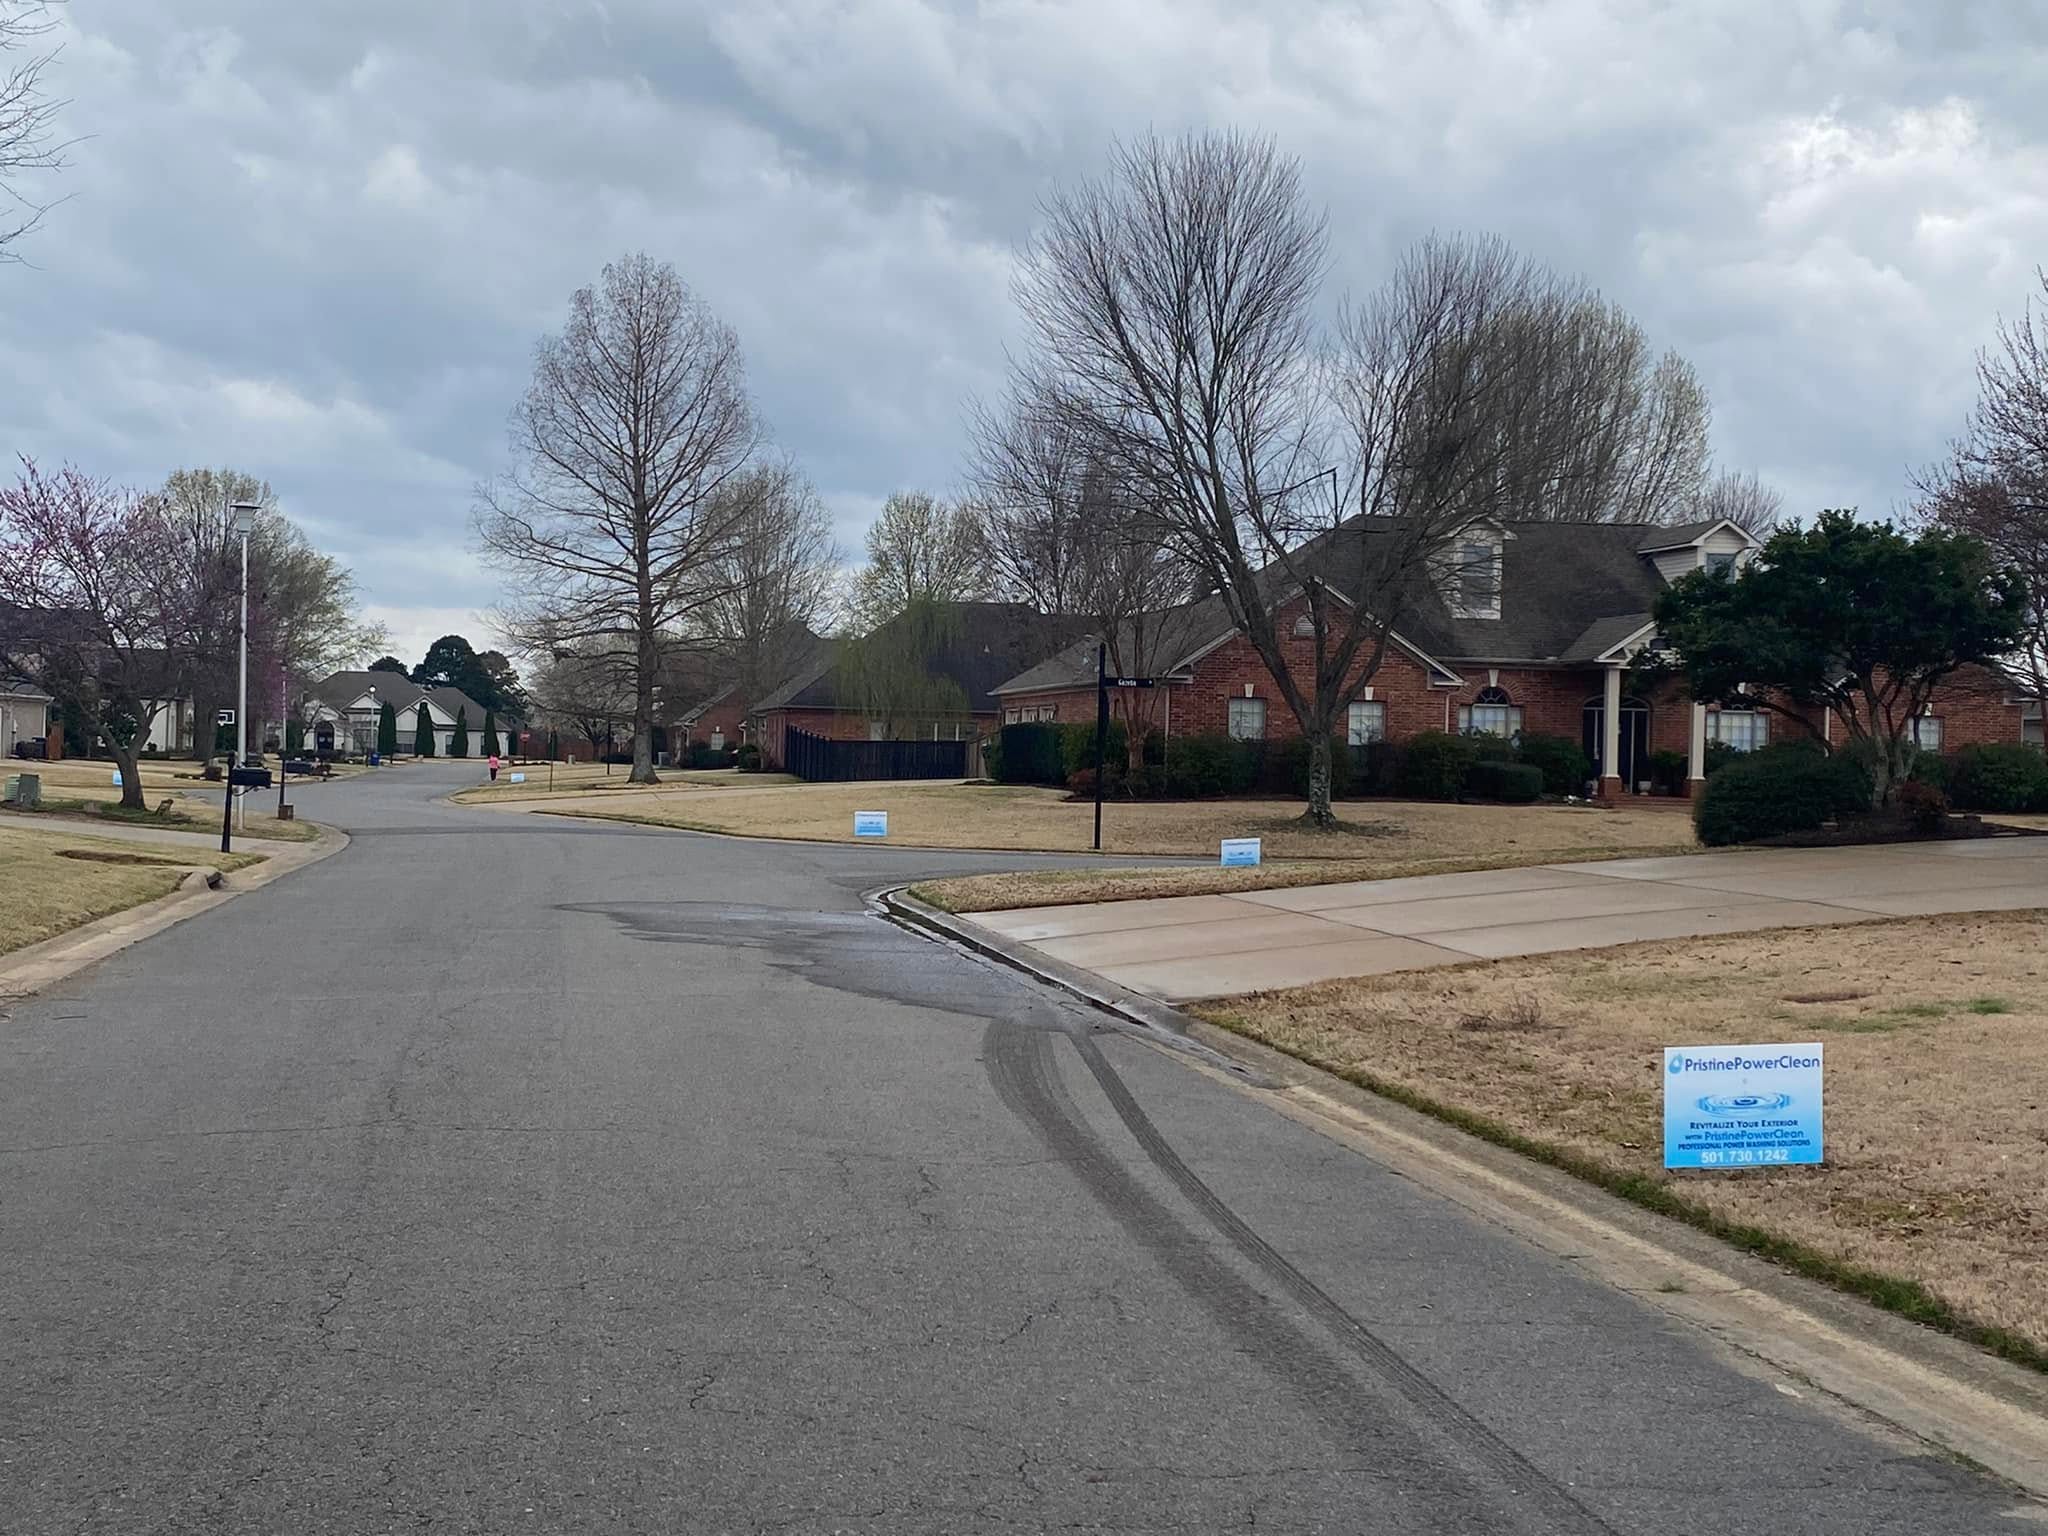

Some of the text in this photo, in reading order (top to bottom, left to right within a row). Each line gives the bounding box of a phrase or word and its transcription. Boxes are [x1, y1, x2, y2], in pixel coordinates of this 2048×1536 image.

[1685, 1055, 1820, 1072] PristinePowerClean
[1705, 1129, 1804, 1141] PristinePowerClean
[1777, 1139, 1811, 1147] SOLUTIONS
[1701, 1150, 1789, 1163] 501.730.1242
